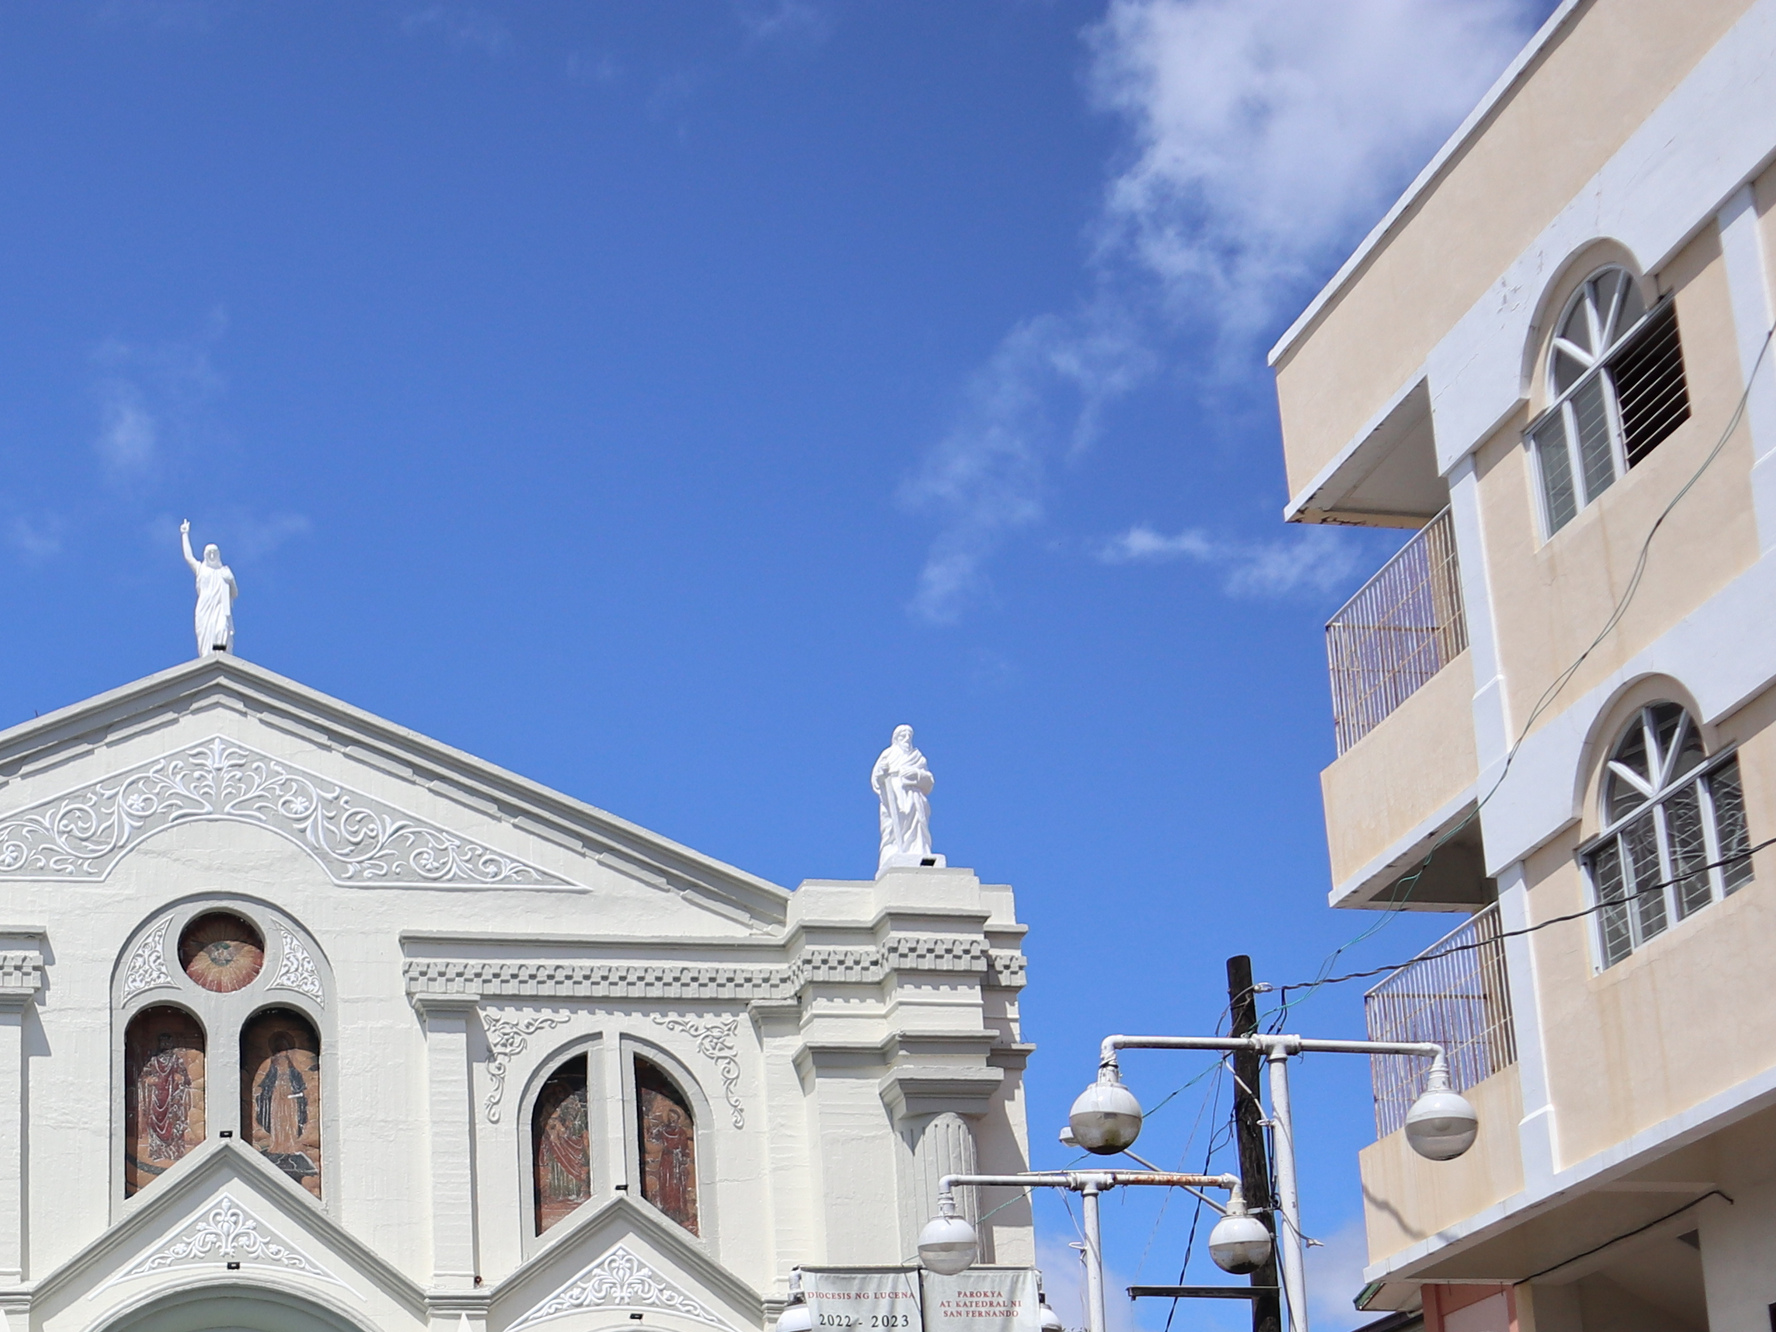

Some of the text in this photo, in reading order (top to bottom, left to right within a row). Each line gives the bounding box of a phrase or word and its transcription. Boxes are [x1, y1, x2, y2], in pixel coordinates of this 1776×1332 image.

[807, 1291, 915, 1300] DIOCESIS NG LUCENA
[957, 1290, 1003, 1298] PAROKYA
[939, 1300, 1022, 1308] AT KATEDRAL NI
[943, 1310, 1019, 1318] SAN FERNANDO
[819, 1314, 852, 1328] 2022
[871, 1314, 910, 1328] 2023
